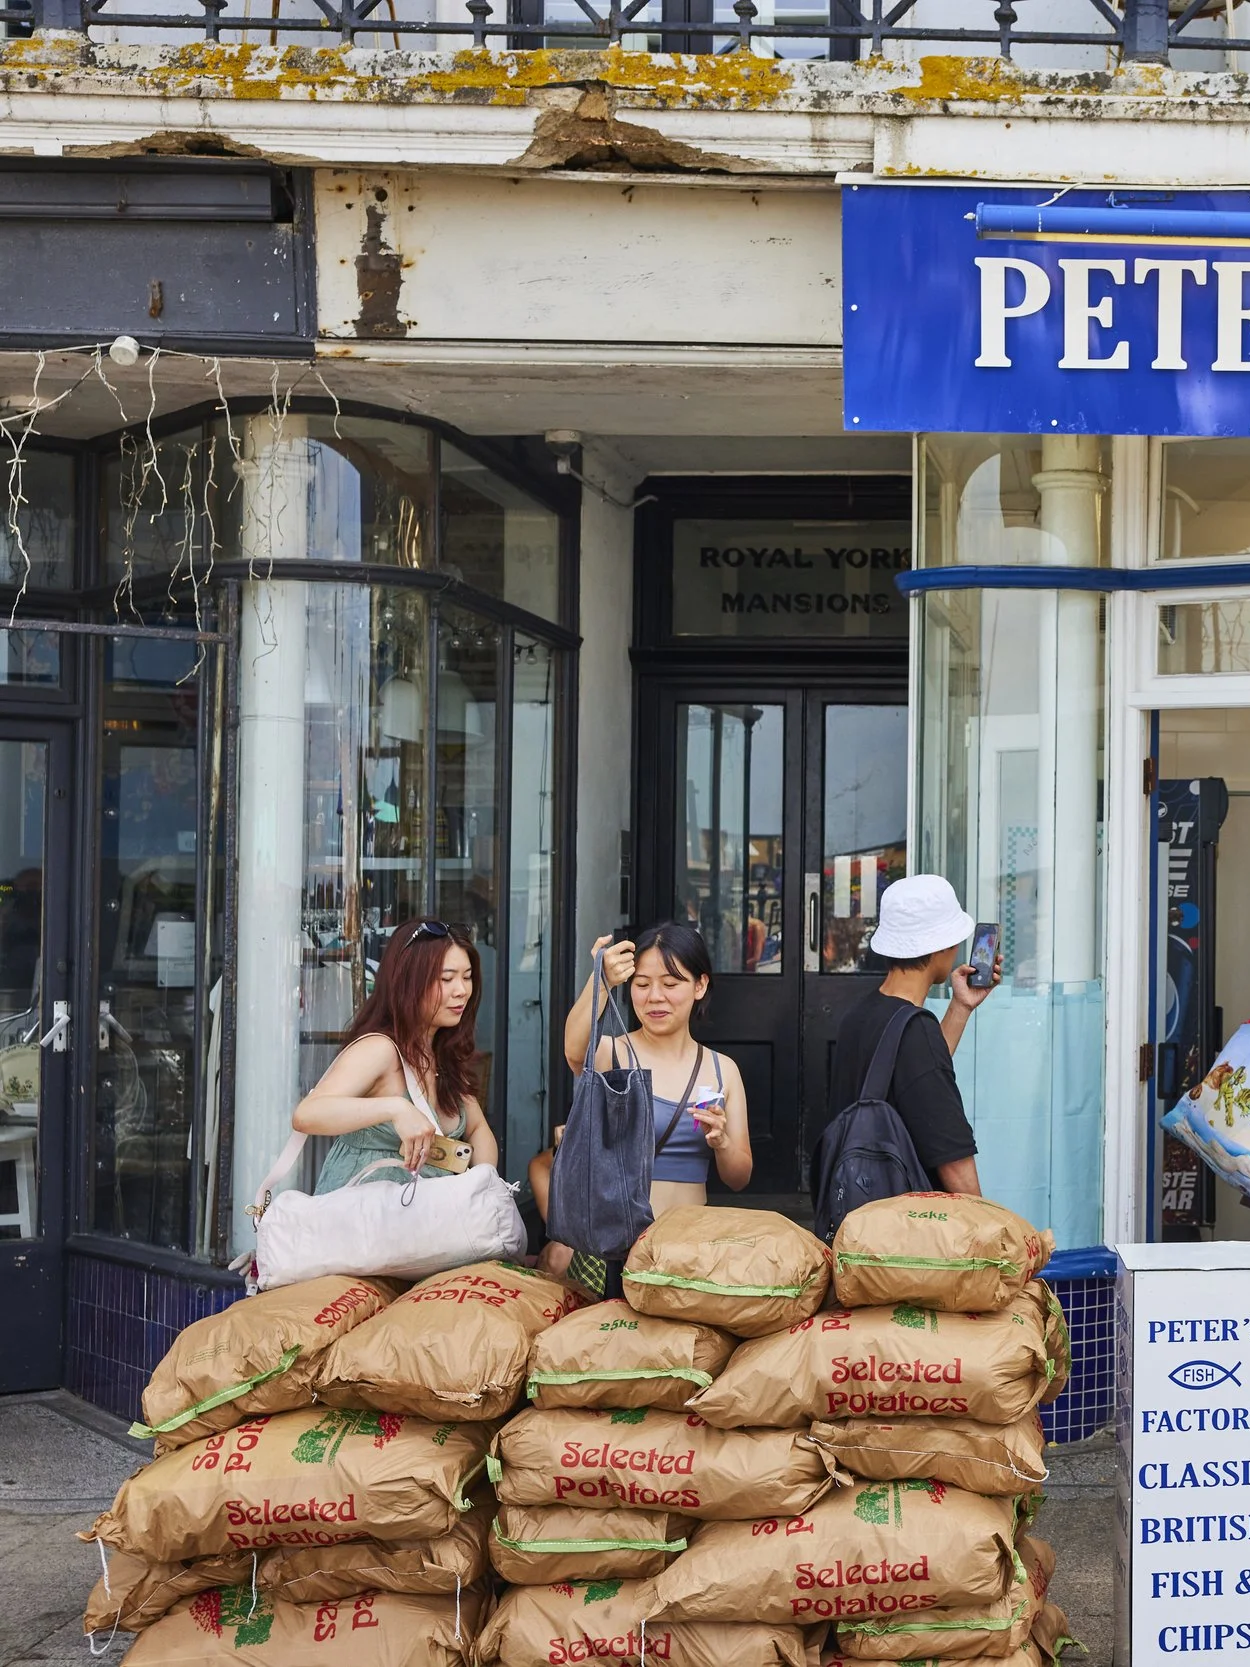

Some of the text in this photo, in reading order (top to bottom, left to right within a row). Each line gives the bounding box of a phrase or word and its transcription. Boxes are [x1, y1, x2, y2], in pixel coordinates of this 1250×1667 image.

[700, 547, 813, 569] ROYAL
[721, 592, 891, 614] MANSIONS
[599, 1318, 639, 1331] 25kg
[831, 1355, 963, 1385] Selected
[1183, 1367, 1215, 1383] FISH
[826, 1391, 969, 1418] Potatoes
[560, 1441, 696, 1476] Selected
[553, 1475, 700, 1509] Potatoes
[226, 1494, 358, 1526] Selected
[796, 1555, 930, 1590] Selected
[1151, 1569, 1224, 1599] FISH
[789, 1592, 938, 1618] Potatoes
[548, 1630, 672, 1666] Selected
